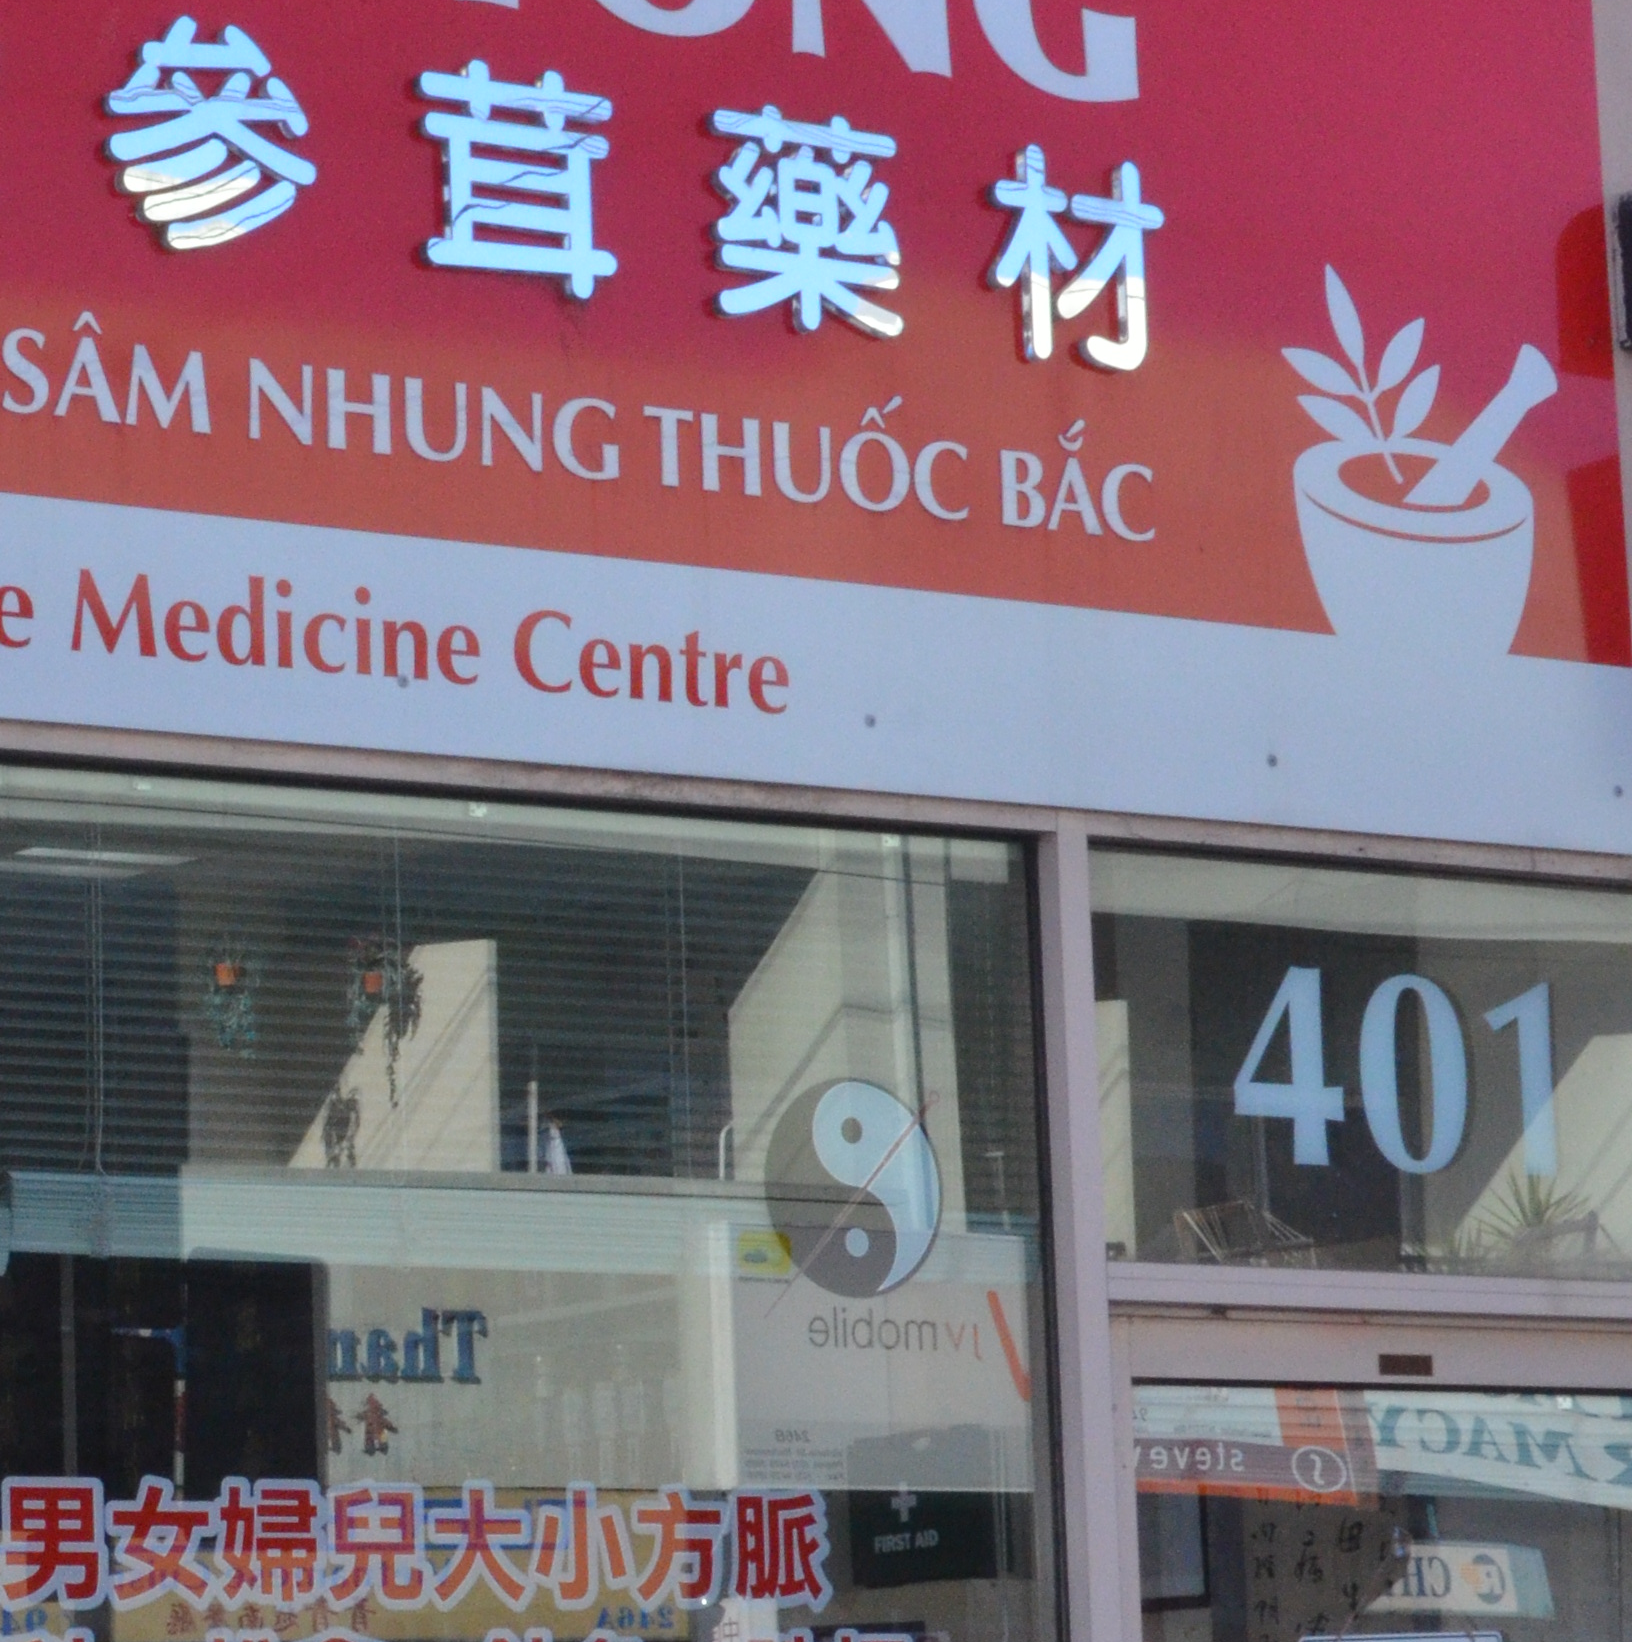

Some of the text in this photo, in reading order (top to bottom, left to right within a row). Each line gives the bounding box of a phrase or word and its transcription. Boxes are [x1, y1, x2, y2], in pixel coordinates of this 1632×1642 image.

[1, 311, 213, 435] SÂM
[249, 358, 619, 483] NHUNG
[642, 395, 968, 522] THUỐC
[999, 420, 1157, 545] BẮC
[70, 567, 480, 687] Medicine
[513, 608, 791, 716] Centre
[1233, 965, 1558, 1177] 401
[874, 1530, 940, 1554] FIRST AID
